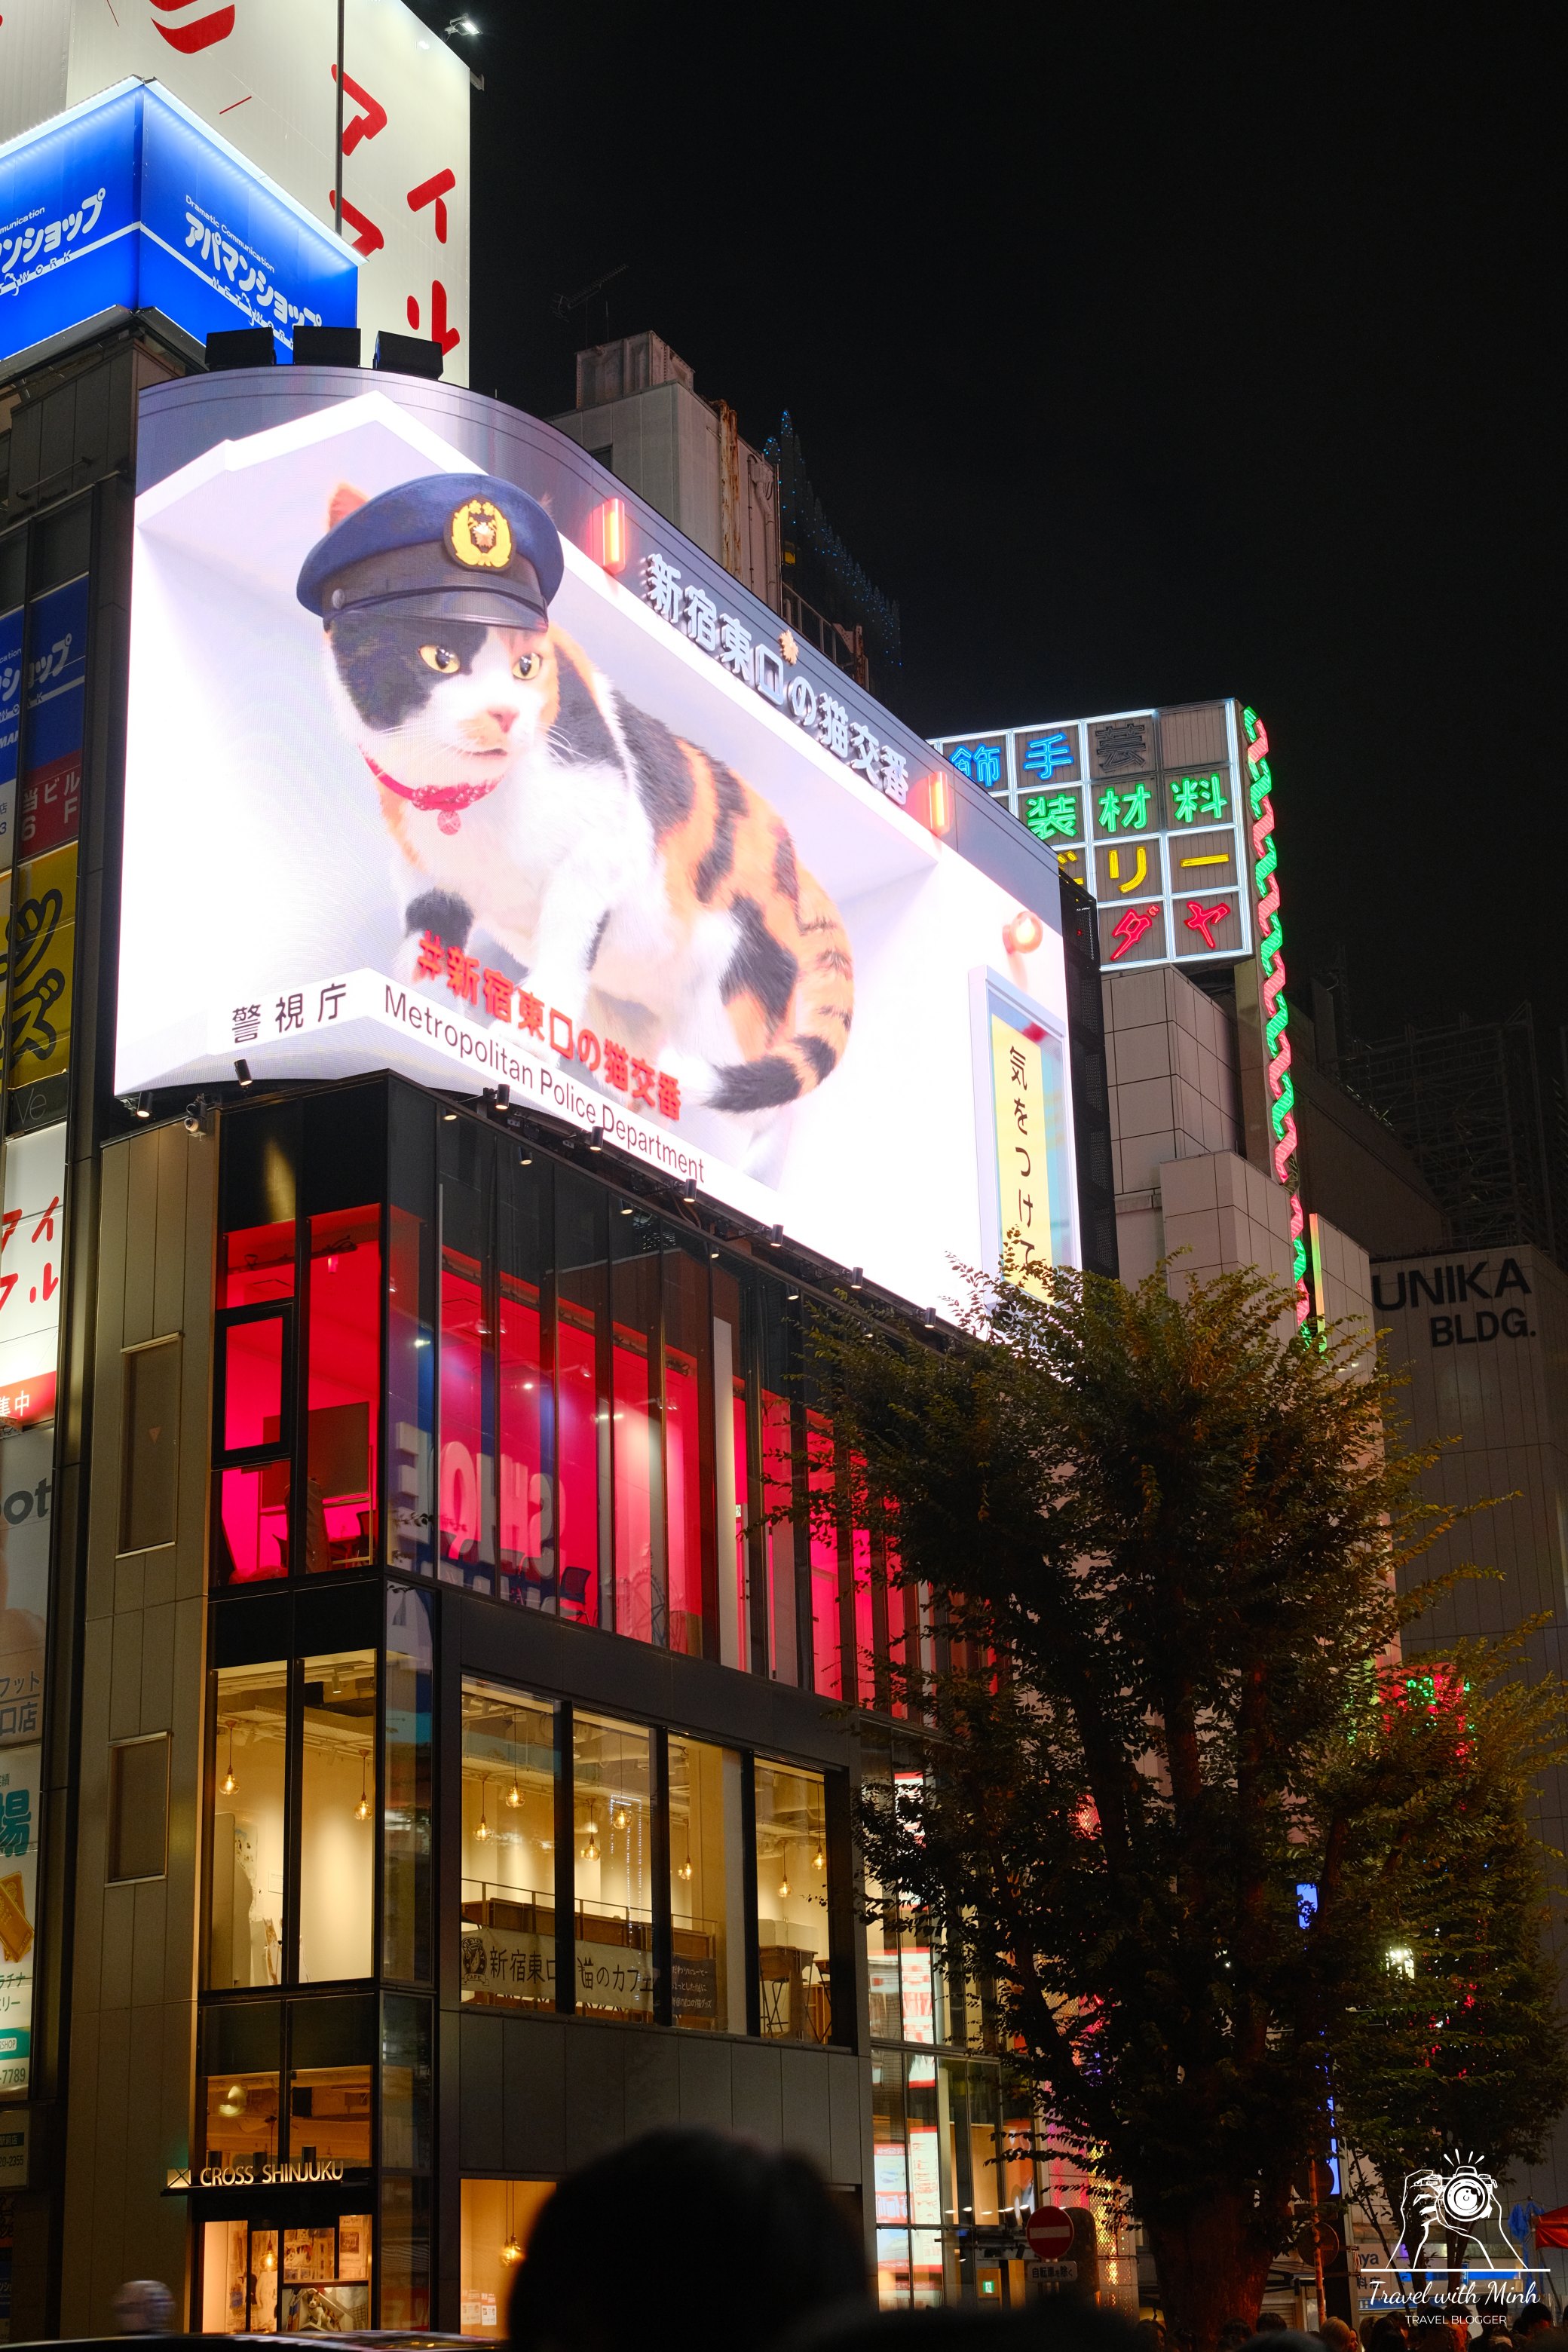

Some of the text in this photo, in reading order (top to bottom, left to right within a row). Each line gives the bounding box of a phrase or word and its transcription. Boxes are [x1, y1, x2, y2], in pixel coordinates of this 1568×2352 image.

[185, 194, 275, 274] Dramatic Communication
[642, 554, 909, 805] 新宿東口の猫交番
[23, 771, 80, 814] 当ビル
[231, 982, 348, 1044] 警視庁
[418, 929, 681, 1121] #新宿東口の猫交番
[384, 984, 706, 1184] Metropolitan Police Department
[1371, 1257, 1532, 1312] UNIKA
[1430, 1307, 1536, 1348] BLDG.
[200, 2160, 344, 2187] CROSS SHINJUKU
